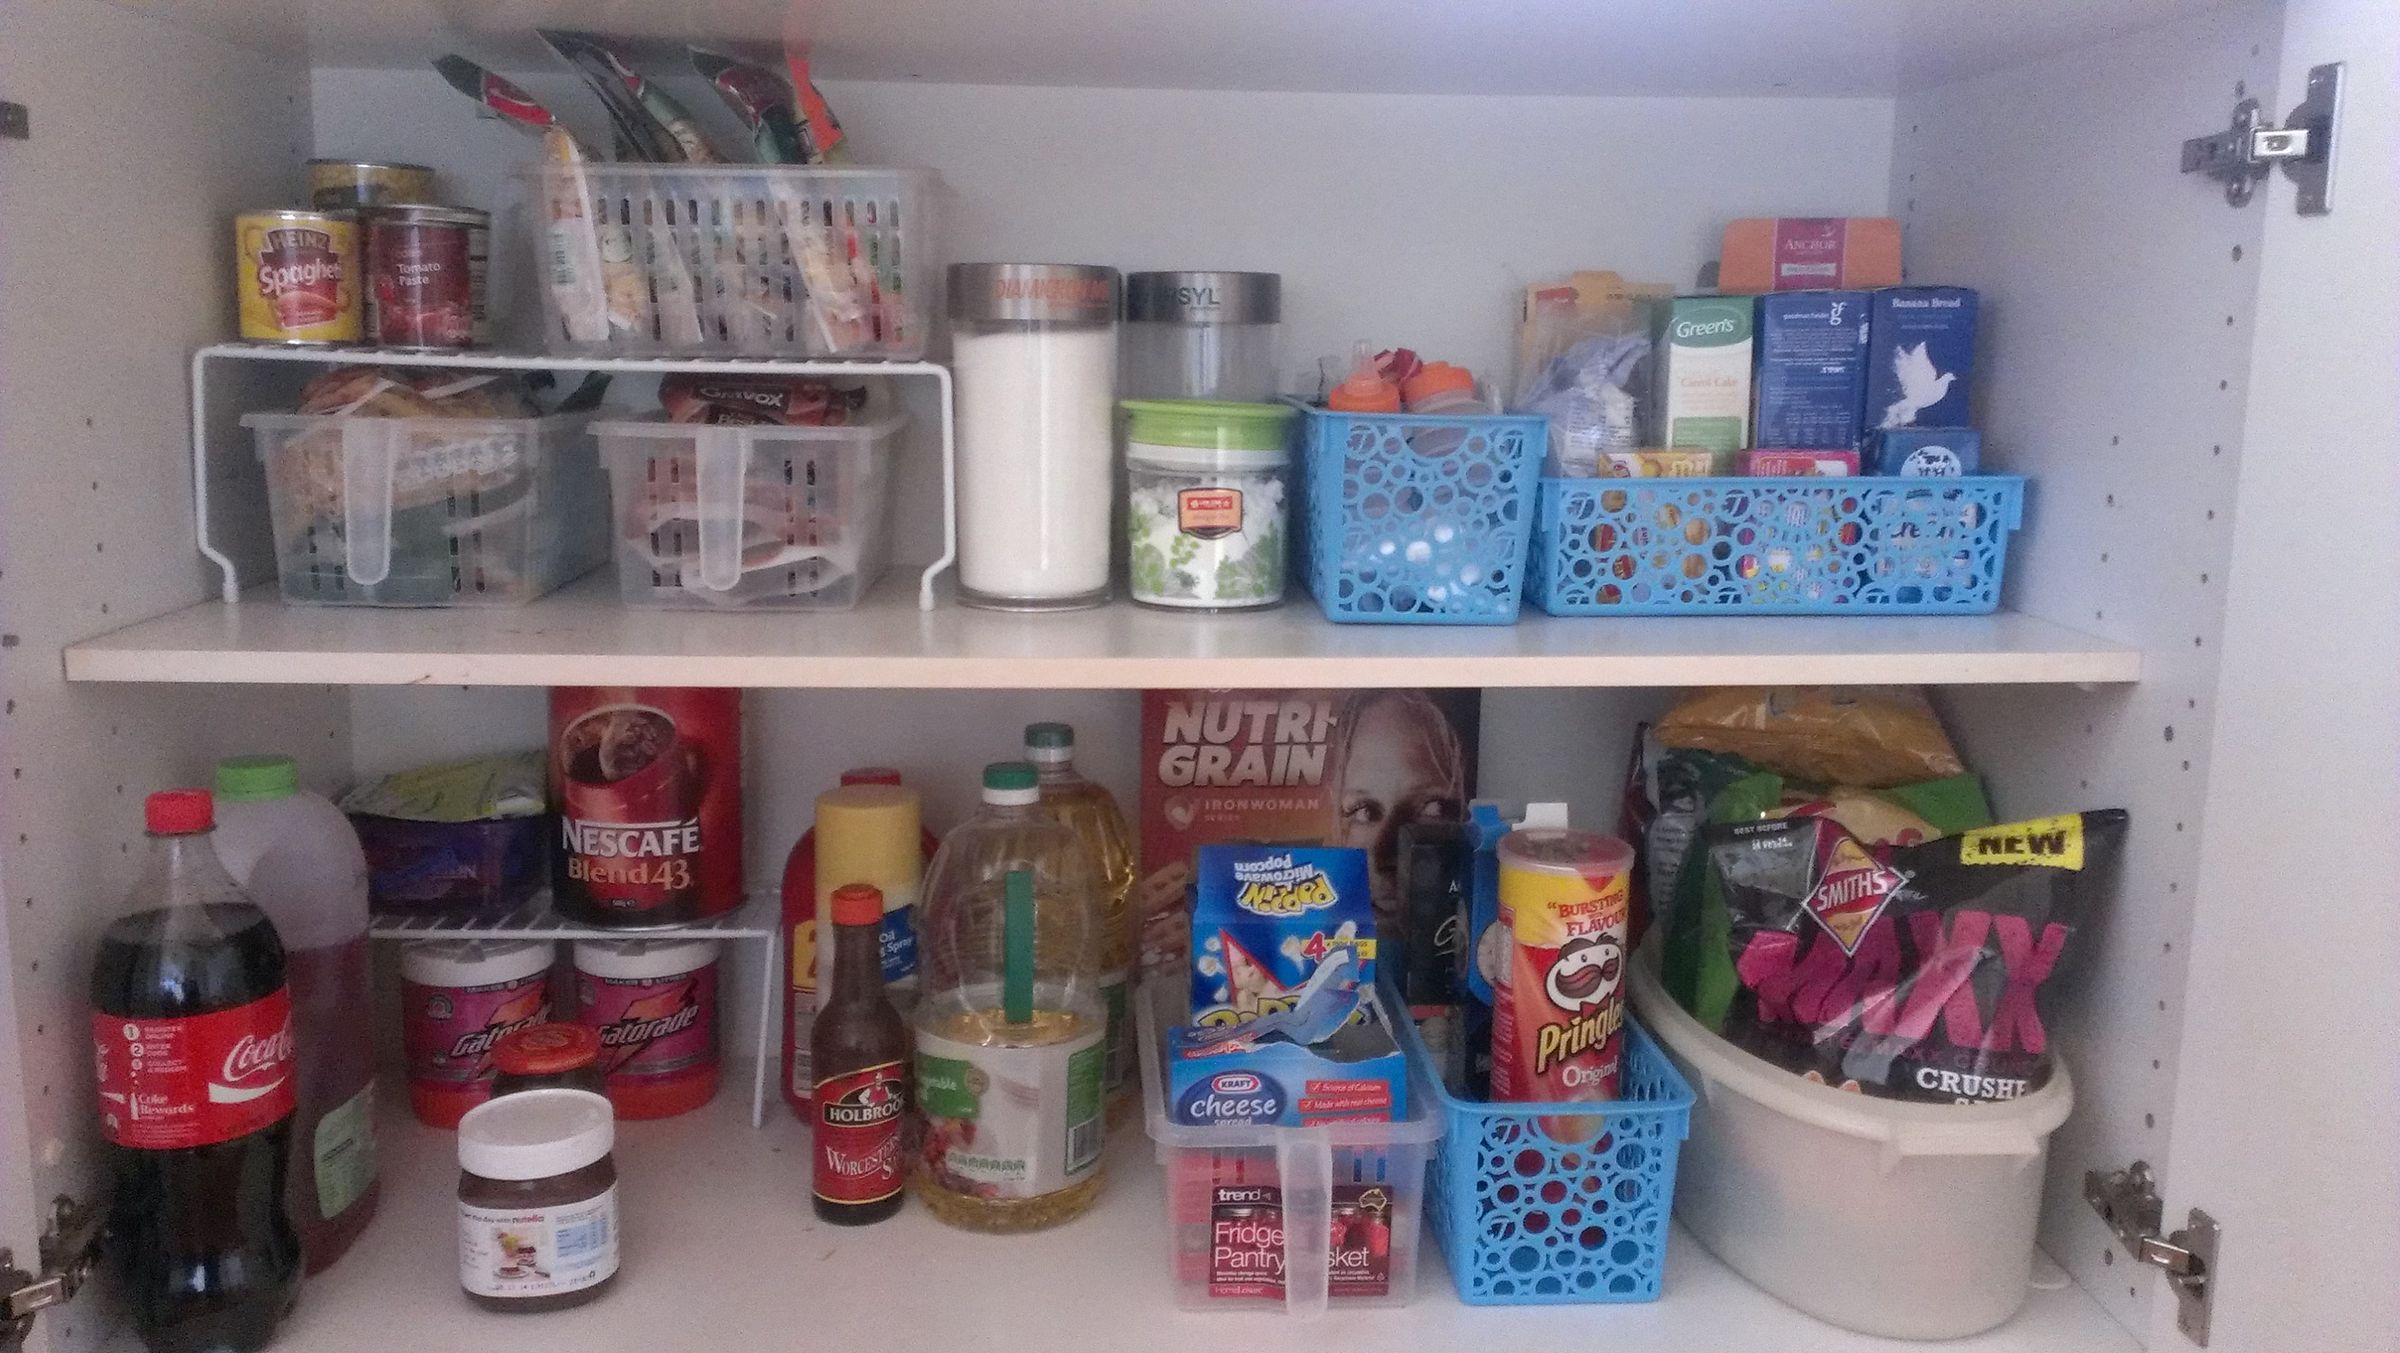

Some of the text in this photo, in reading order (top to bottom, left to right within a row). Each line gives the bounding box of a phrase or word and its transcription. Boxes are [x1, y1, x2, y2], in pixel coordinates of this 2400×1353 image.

[397, 262, 441, 275] Tomato
[398, 275, 430, 286] Paste
[1676, 317, 1735, 338] Green's
[1158, 744, 1329, 787] GRAIN
[1204, 799, 1320, 811] IRONWOMAN
[562, 815, 700, 858] NESCAFÉ
[1977, 831, 2068, 856] NEW
[567, 857, 691, 891] Blend 43
[1303, 931, 1327, 961] 4
[1220, 1079, 1251, 1089] KRAFT
[141, 1104, 195, 1115] Rewards
[1190, 1093, 1277, 1118] cheese
[1217, 1189, 1261, 1201] trend
[1214, 1222, 1285, 1249] Fridge
[1213, 1246, 1286, 1275] Pantry
[1328, 1246, 1370, 1268] sket
